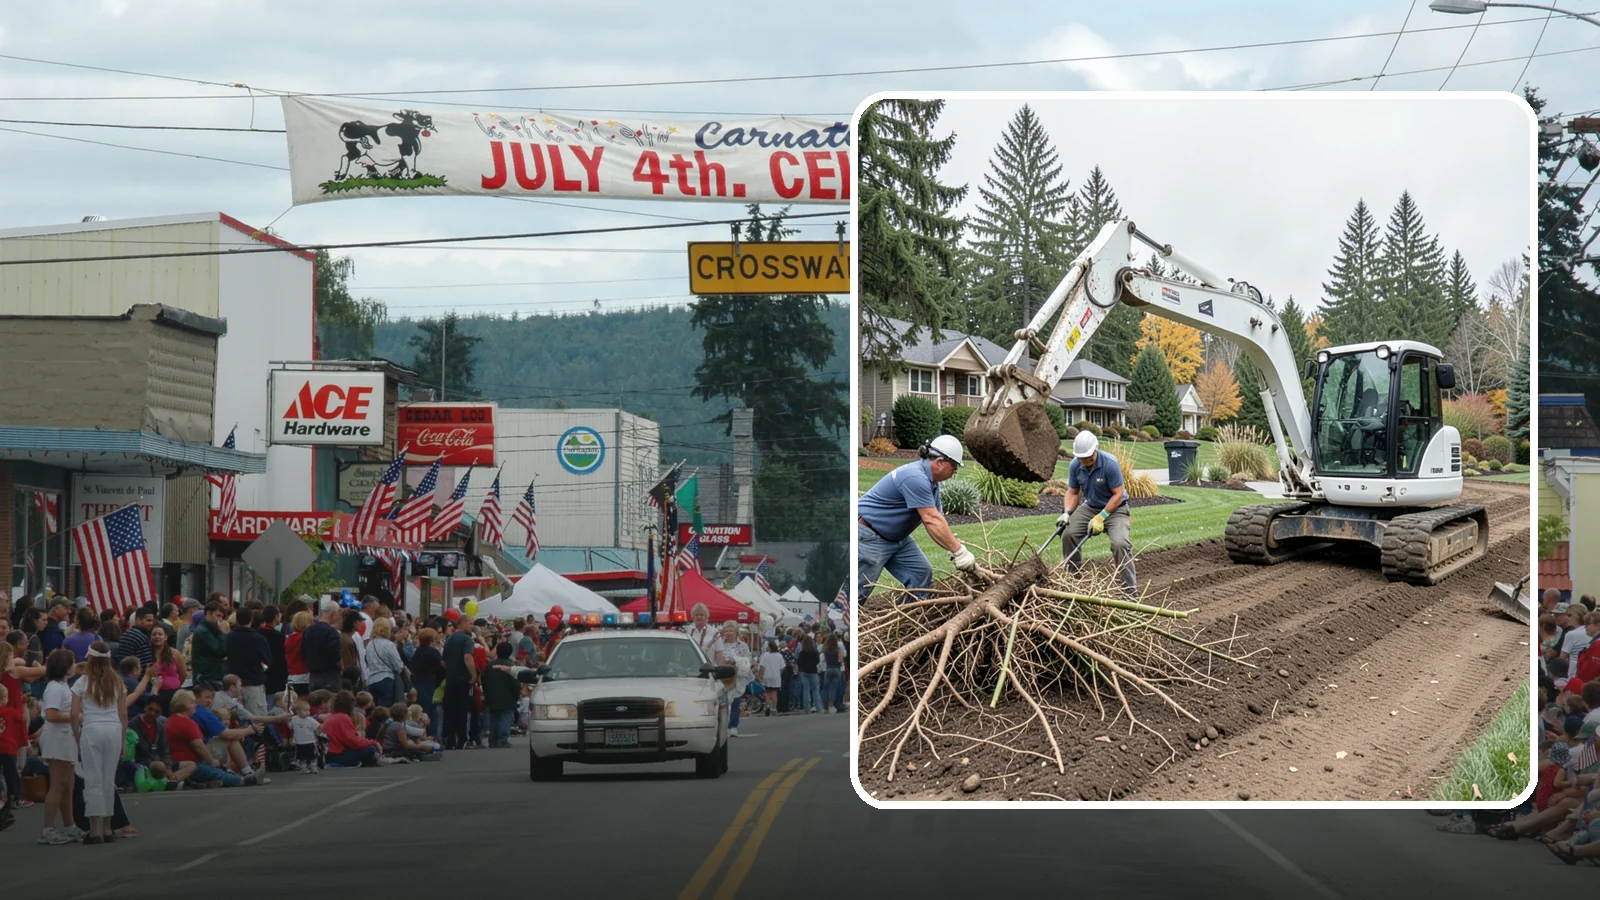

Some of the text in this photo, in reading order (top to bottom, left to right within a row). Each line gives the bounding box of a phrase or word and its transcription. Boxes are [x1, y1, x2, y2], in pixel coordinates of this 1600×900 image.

[481, 140, 604, 192] JULY
[632, 150, 746, 197] 4th.
[696, 254, 850, 280] CROSSWA
[282, 380, 373, 420] ACE
[283, 421, 370, 436] Hardware
[416, 428, 476, 447] Coca-Cola
[96, 485, 124, 495] Vincent
[126, 486, 135, 495] de
[137, 486, 155, 495] Paul
[212, 515, 330, 535] HARDARE
[688, 526, 741, 535] CRNATION
[699, 535, 730, 543] GLASS
